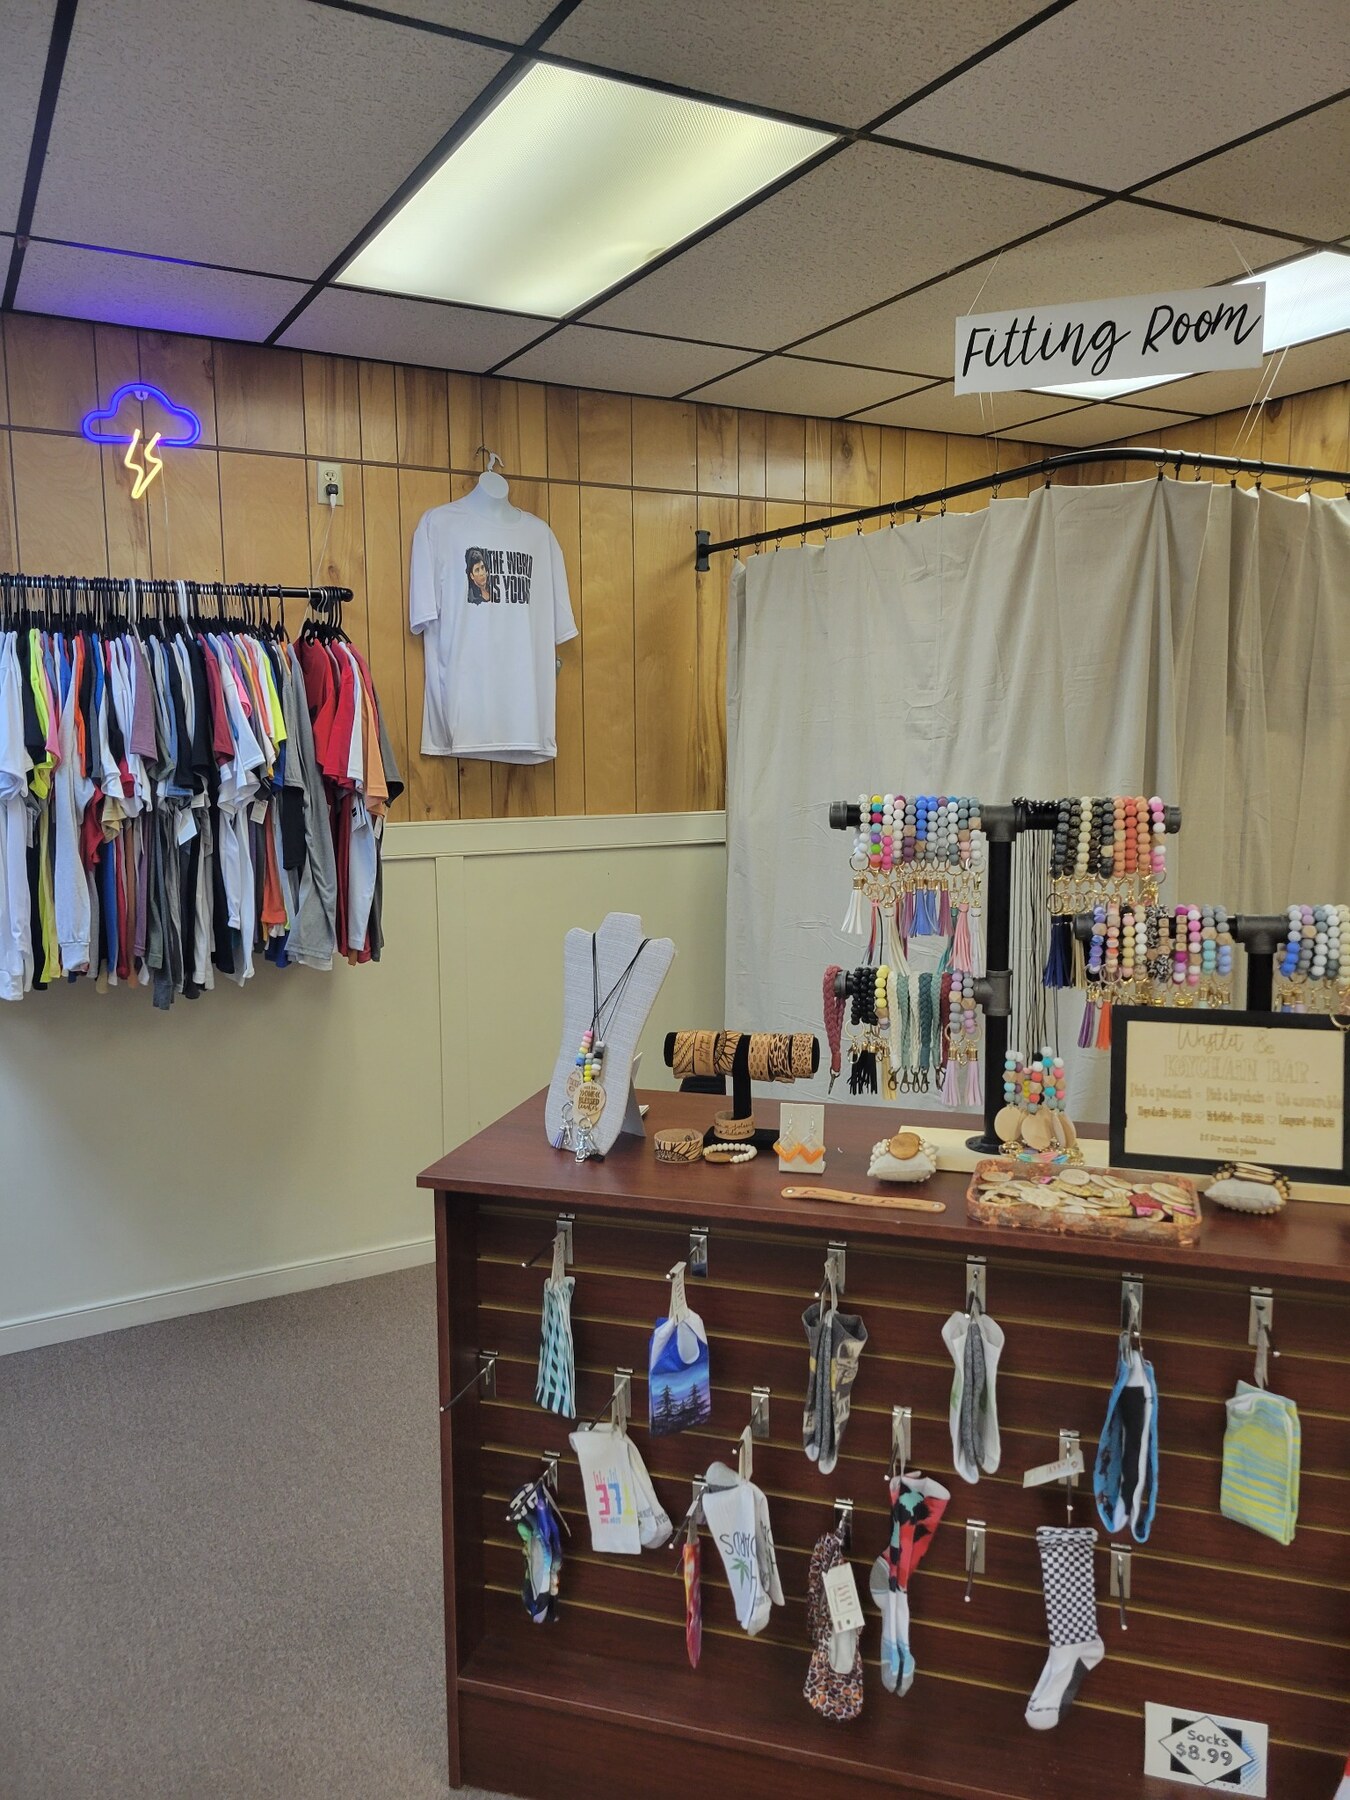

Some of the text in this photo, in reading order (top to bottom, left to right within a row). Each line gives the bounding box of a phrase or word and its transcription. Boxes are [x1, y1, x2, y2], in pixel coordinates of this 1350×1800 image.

[962, 303, 1262, 376] Fitting Room
[488, 550, 504, 574] THE
[490, 574, 501, 603] IS
[1266, 1059, 1310, 1084] BAR
[1187, 1730, 1229, 1748] Socks
[1176, 1742, 1233, 1767] $8.99
